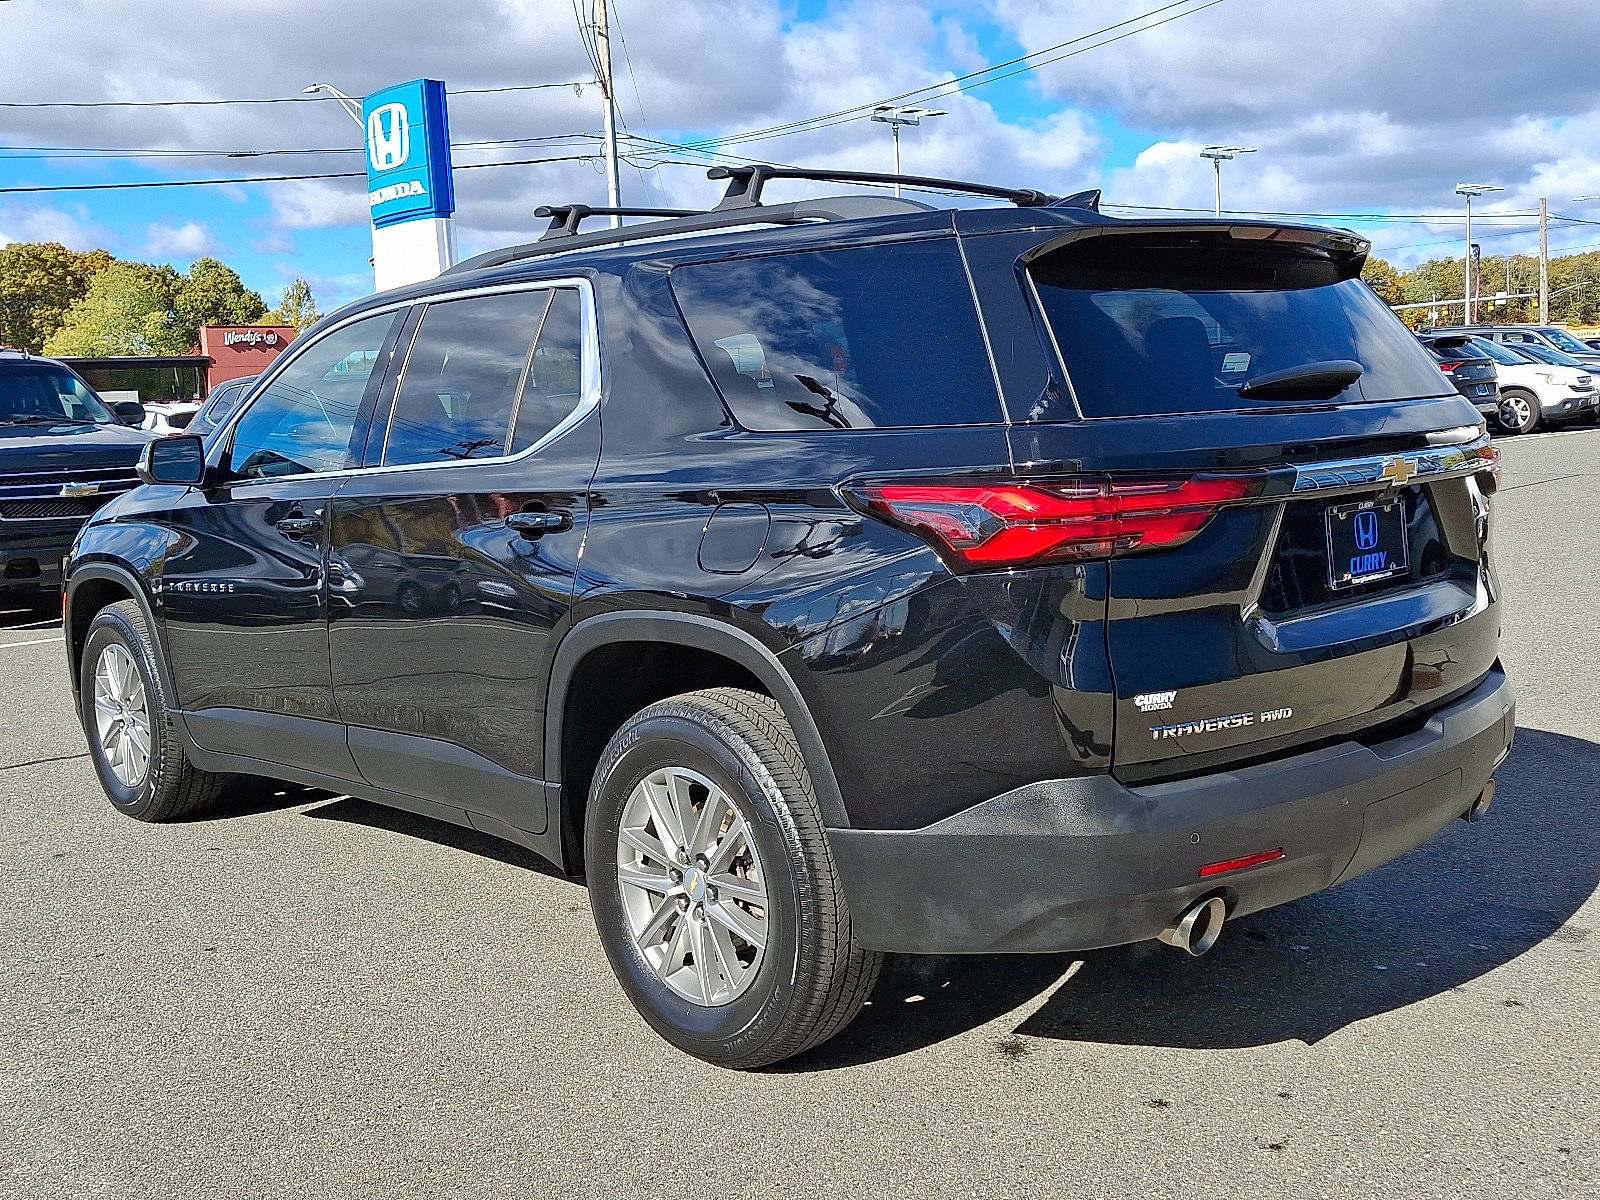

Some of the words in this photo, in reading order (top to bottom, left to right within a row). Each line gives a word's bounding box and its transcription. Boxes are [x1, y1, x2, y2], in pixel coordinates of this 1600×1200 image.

[369, 180, 428, 207] HONDA
[223, 329, 262, 346] Wendy's
[1349, 550, 1387, 575] CURRY
[168, 582, 235, 593] TRAVERSE
[1133, 690, 1178, 707] CURRY
[1140, 701, 1173, 713] HONDA
[1149, 711, 1254, 741] TRAVERSE
[1260, 707, 1293, 723] AWD
